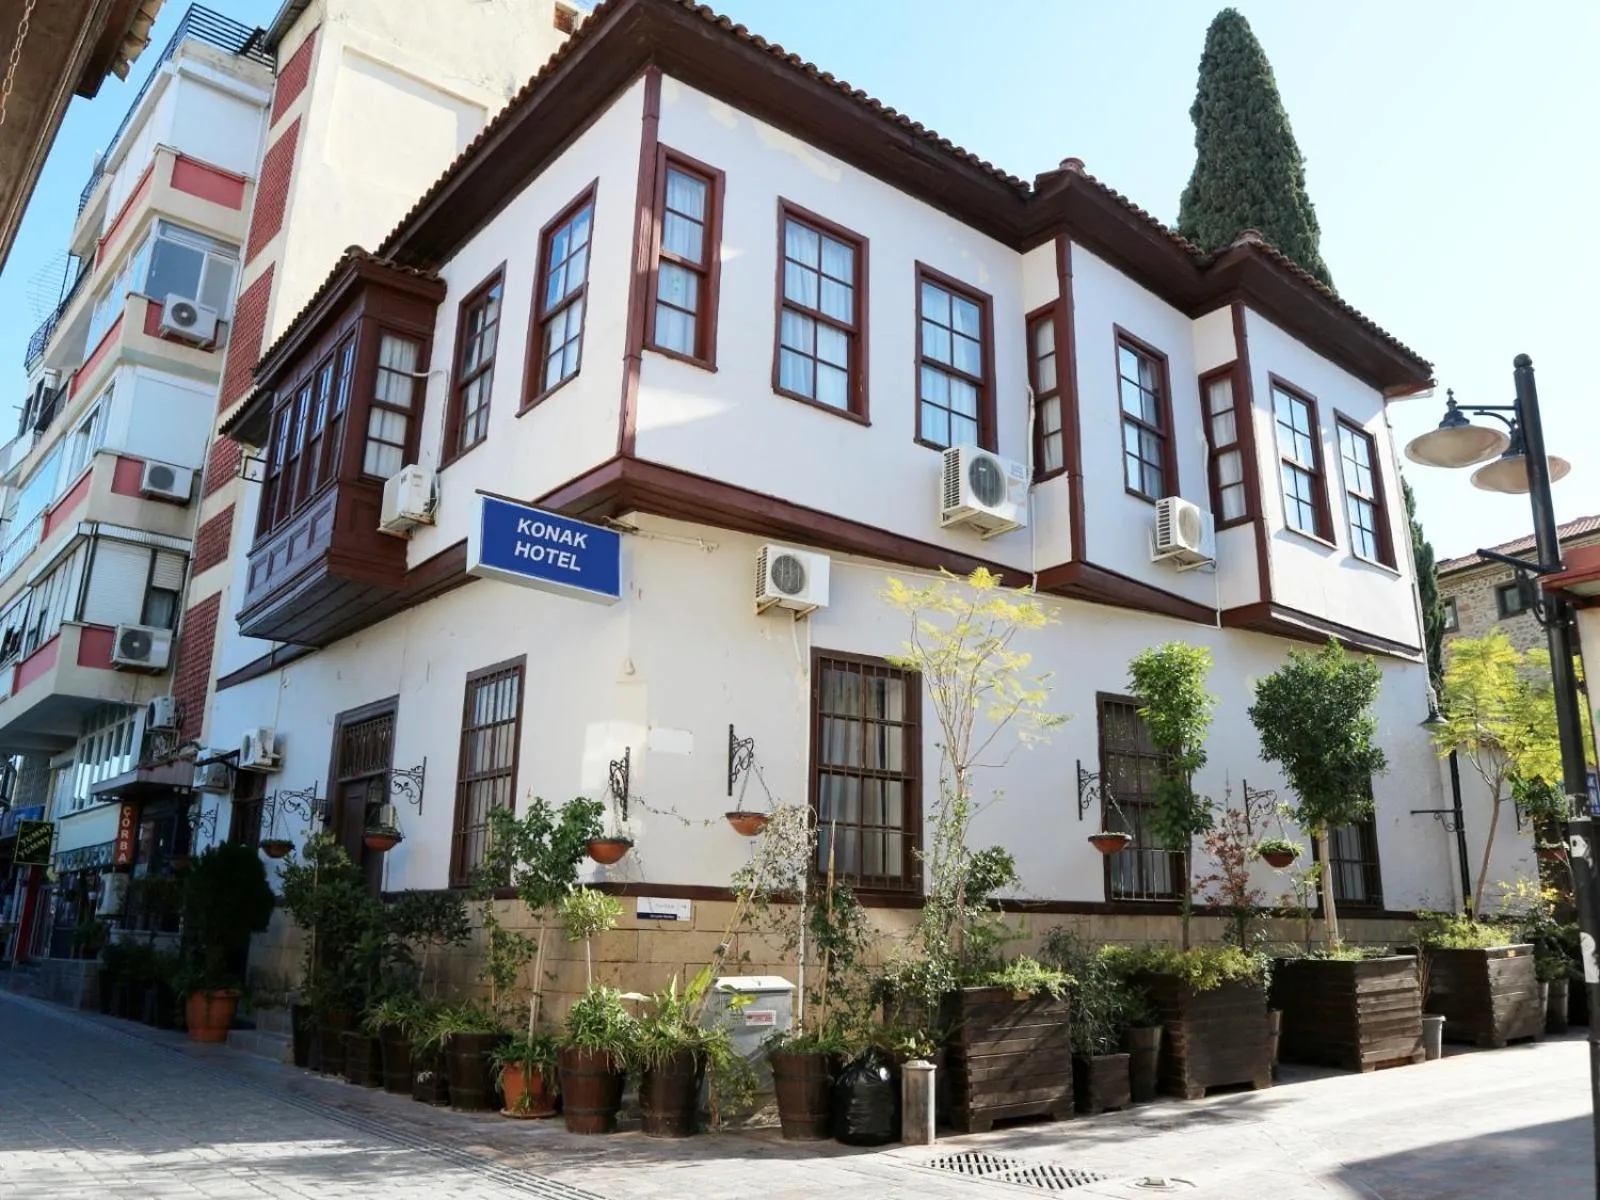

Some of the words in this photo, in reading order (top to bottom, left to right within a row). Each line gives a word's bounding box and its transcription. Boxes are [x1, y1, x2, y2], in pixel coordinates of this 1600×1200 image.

[516, 518, 589, 549] KONAK
[514, 540, 581, 572] HOTEL
[118, 806, 132, 864] ÇORBA
